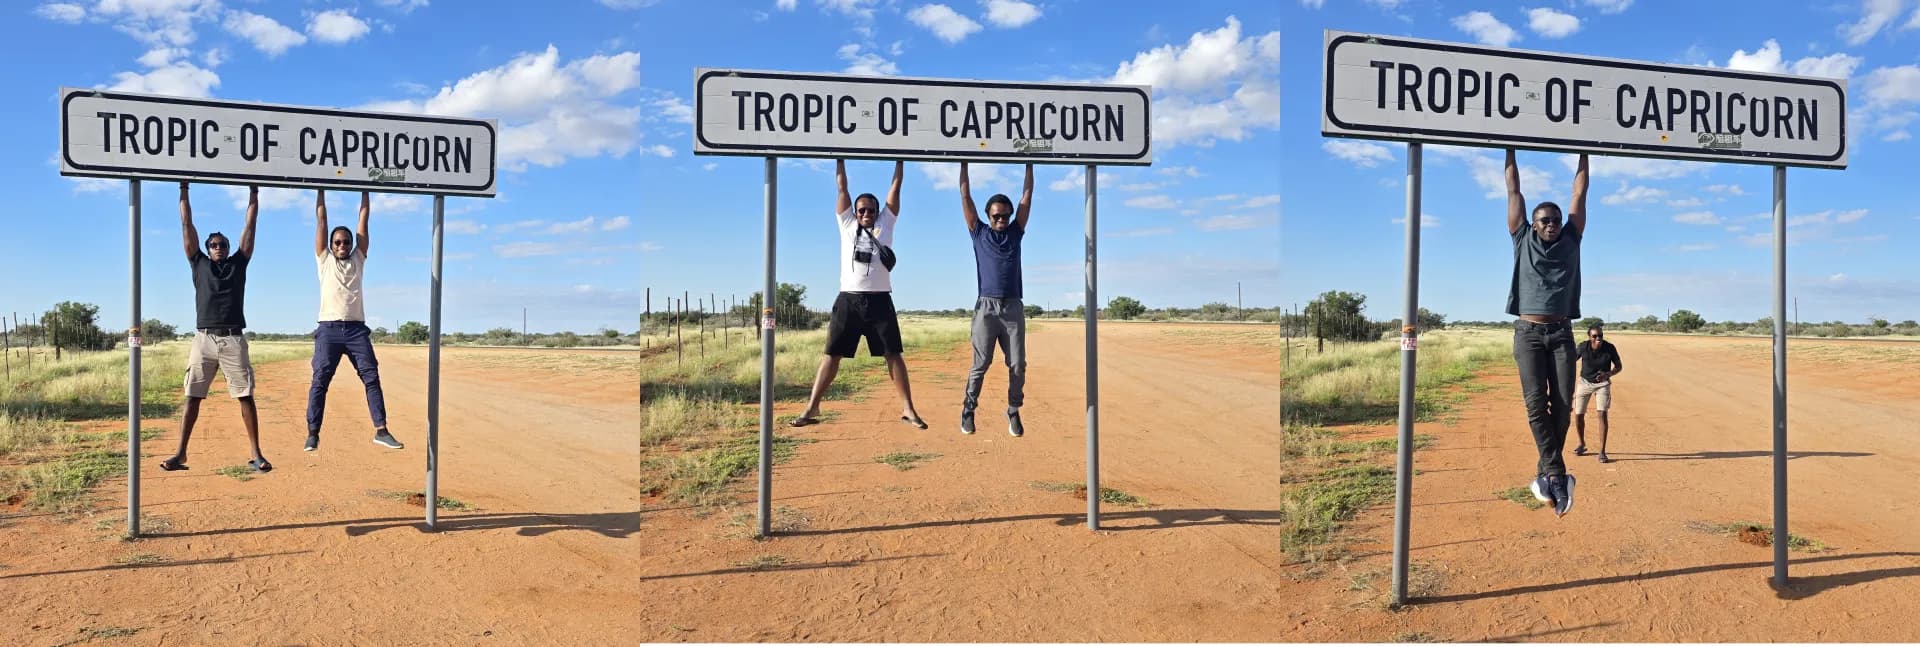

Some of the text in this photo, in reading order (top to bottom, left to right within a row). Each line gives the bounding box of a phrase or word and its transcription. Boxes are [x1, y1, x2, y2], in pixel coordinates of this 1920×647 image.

[732, 91, 1124, 141] TROPIC OF CAPRICORN
[1371, 61, 1818, 140] TROPIC OF CAPRICORN
[97, 112, 472, 173] TROPIC OF CAPRICORN
